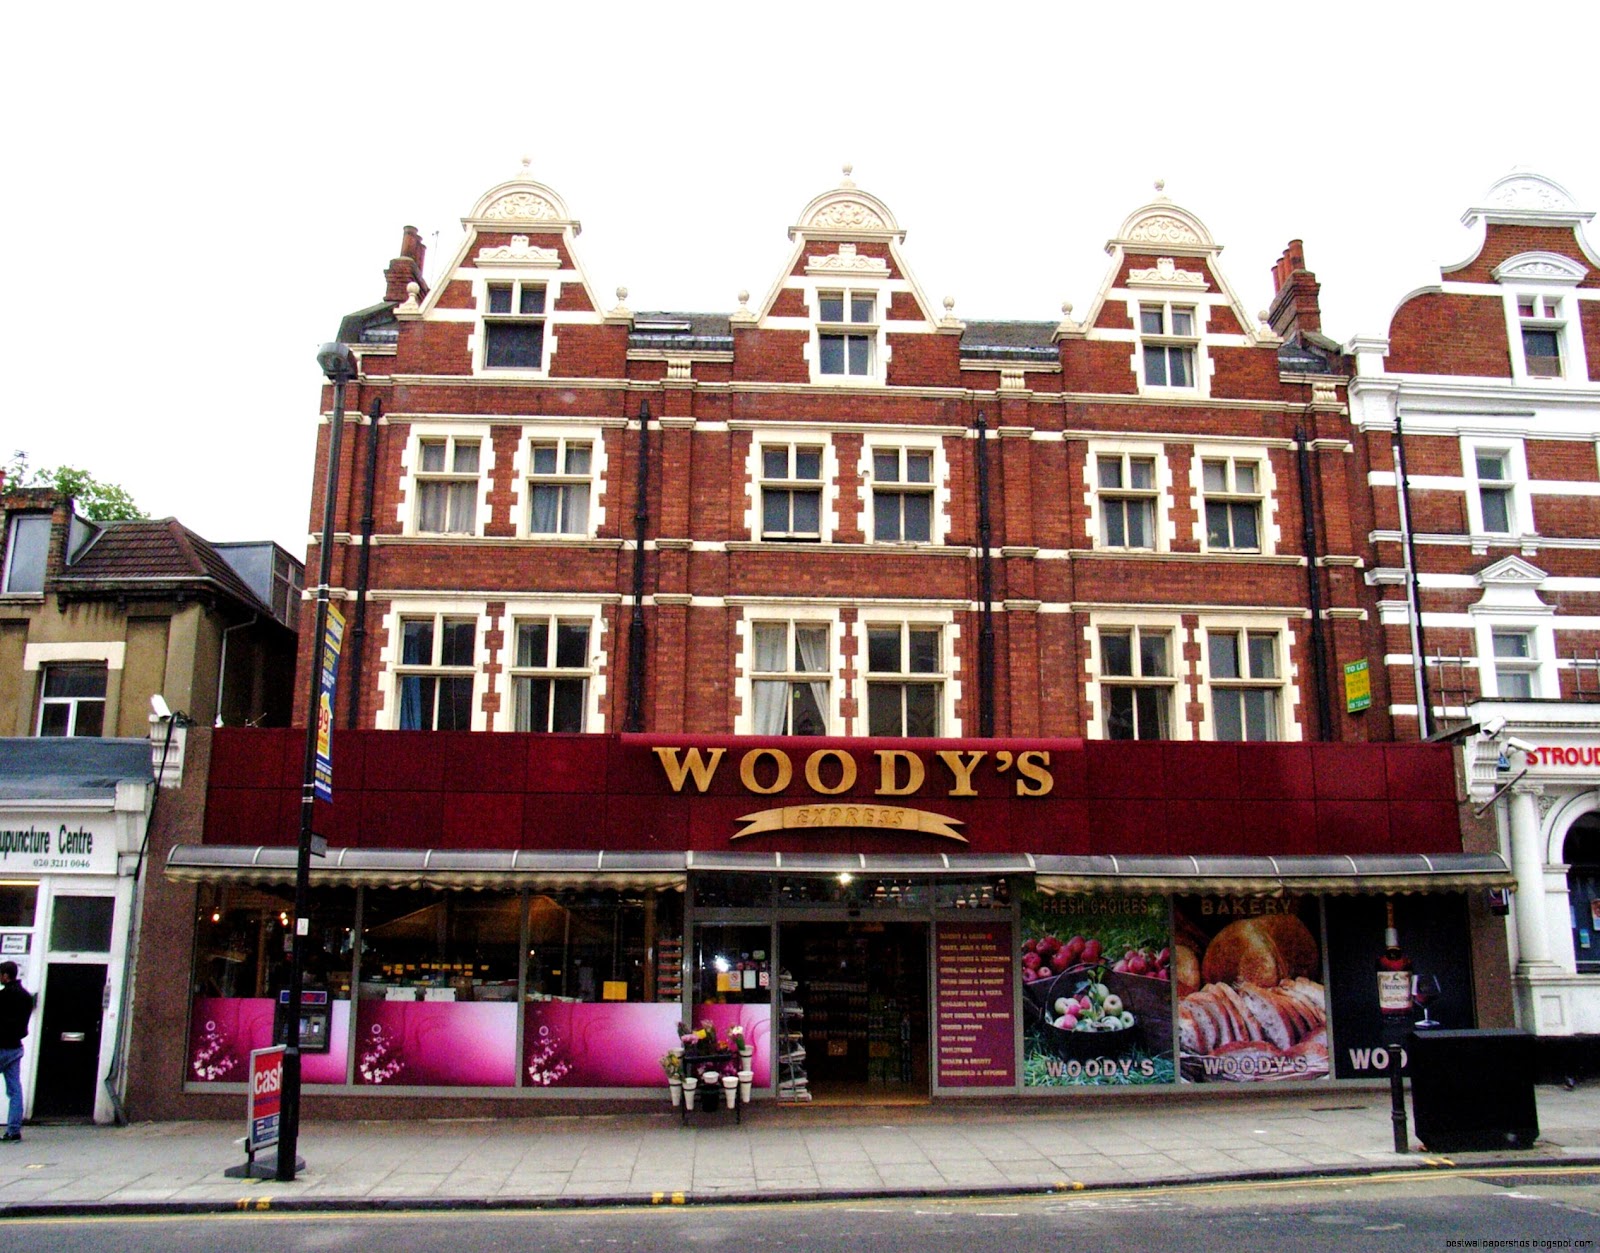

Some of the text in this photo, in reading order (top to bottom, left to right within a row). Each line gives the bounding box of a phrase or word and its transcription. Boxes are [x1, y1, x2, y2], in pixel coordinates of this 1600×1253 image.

[652, 747, 1055, 797] WOODY'S
[796, 806, 905, 825] EXPRESS
[58, 824, 93, 855] Centre
[1042, 899, 1085, 915] FRESH
[1201, 899, 1293, 915] BAKERY
[1047, 1058, 1155, 1077] WOODY'S
[1203, 1055, 1309, 1075] WOODY'S
